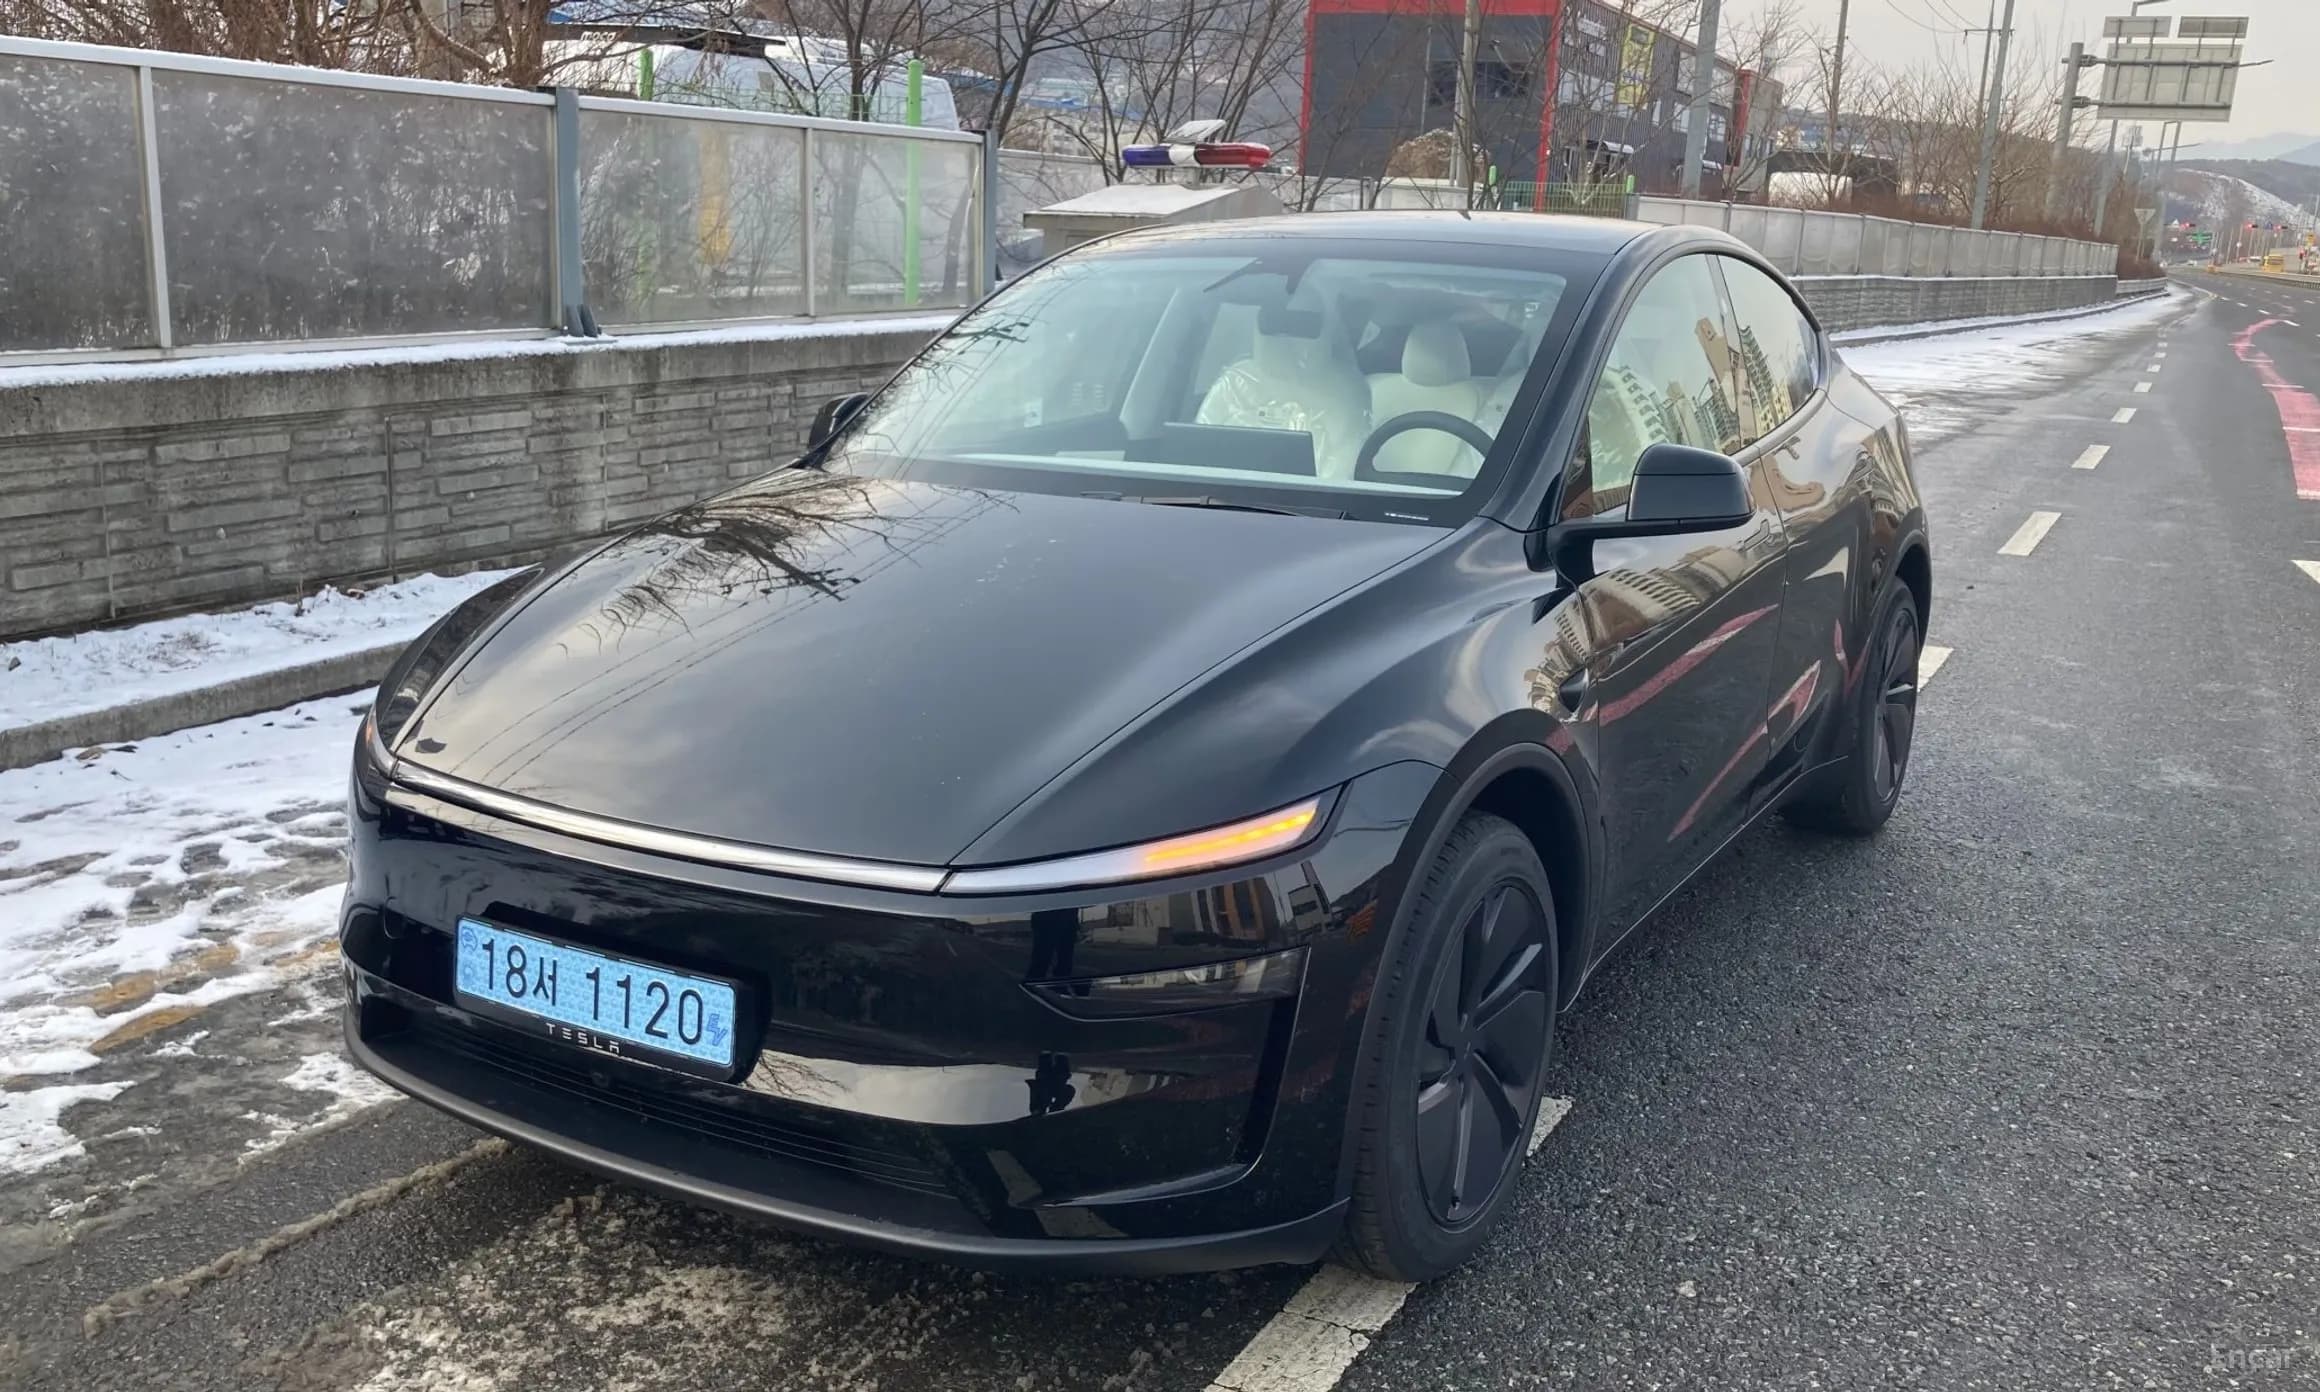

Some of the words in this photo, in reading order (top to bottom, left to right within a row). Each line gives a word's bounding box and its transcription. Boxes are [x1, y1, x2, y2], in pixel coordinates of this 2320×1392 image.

[482, 938, 557, 1006] 18서
[585, 967, 703, 1045] 1120
[546, 1022, 620, 1054] TESLA
[706, 1013, 728, 1047] EV
